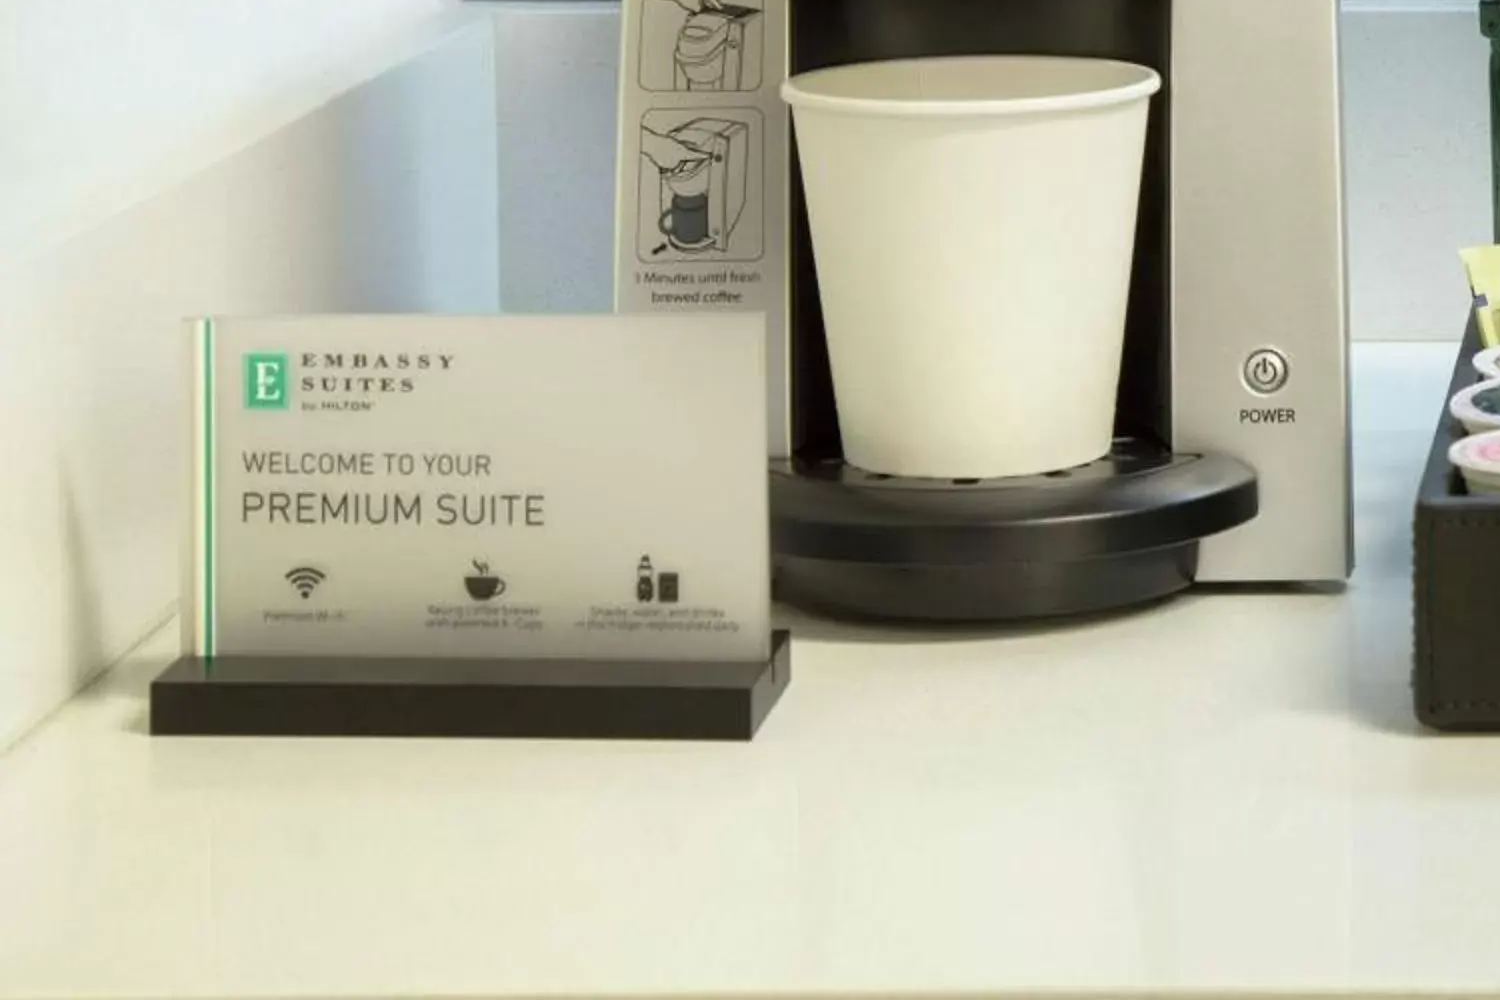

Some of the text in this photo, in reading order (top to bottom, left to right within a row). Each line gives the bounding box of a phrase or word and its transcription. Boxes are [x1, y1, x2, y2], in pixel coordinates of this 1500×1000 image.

[643, 271, 695, 285] Minutes
[697, 270, 728, 284] until
[651, 290, 744, 305] brewed coffee
[255, 353, 456, 400] E EMBASSY
[301, 376, 415, 393] SUITES
[321, 401, 372, 412] HILTON
[1239, 407, 1296, 424] POWER
[242, 451, 491, 477] WELCOME TO YOUR
[242, 491, 545, 526] PREMIUM SUITE
